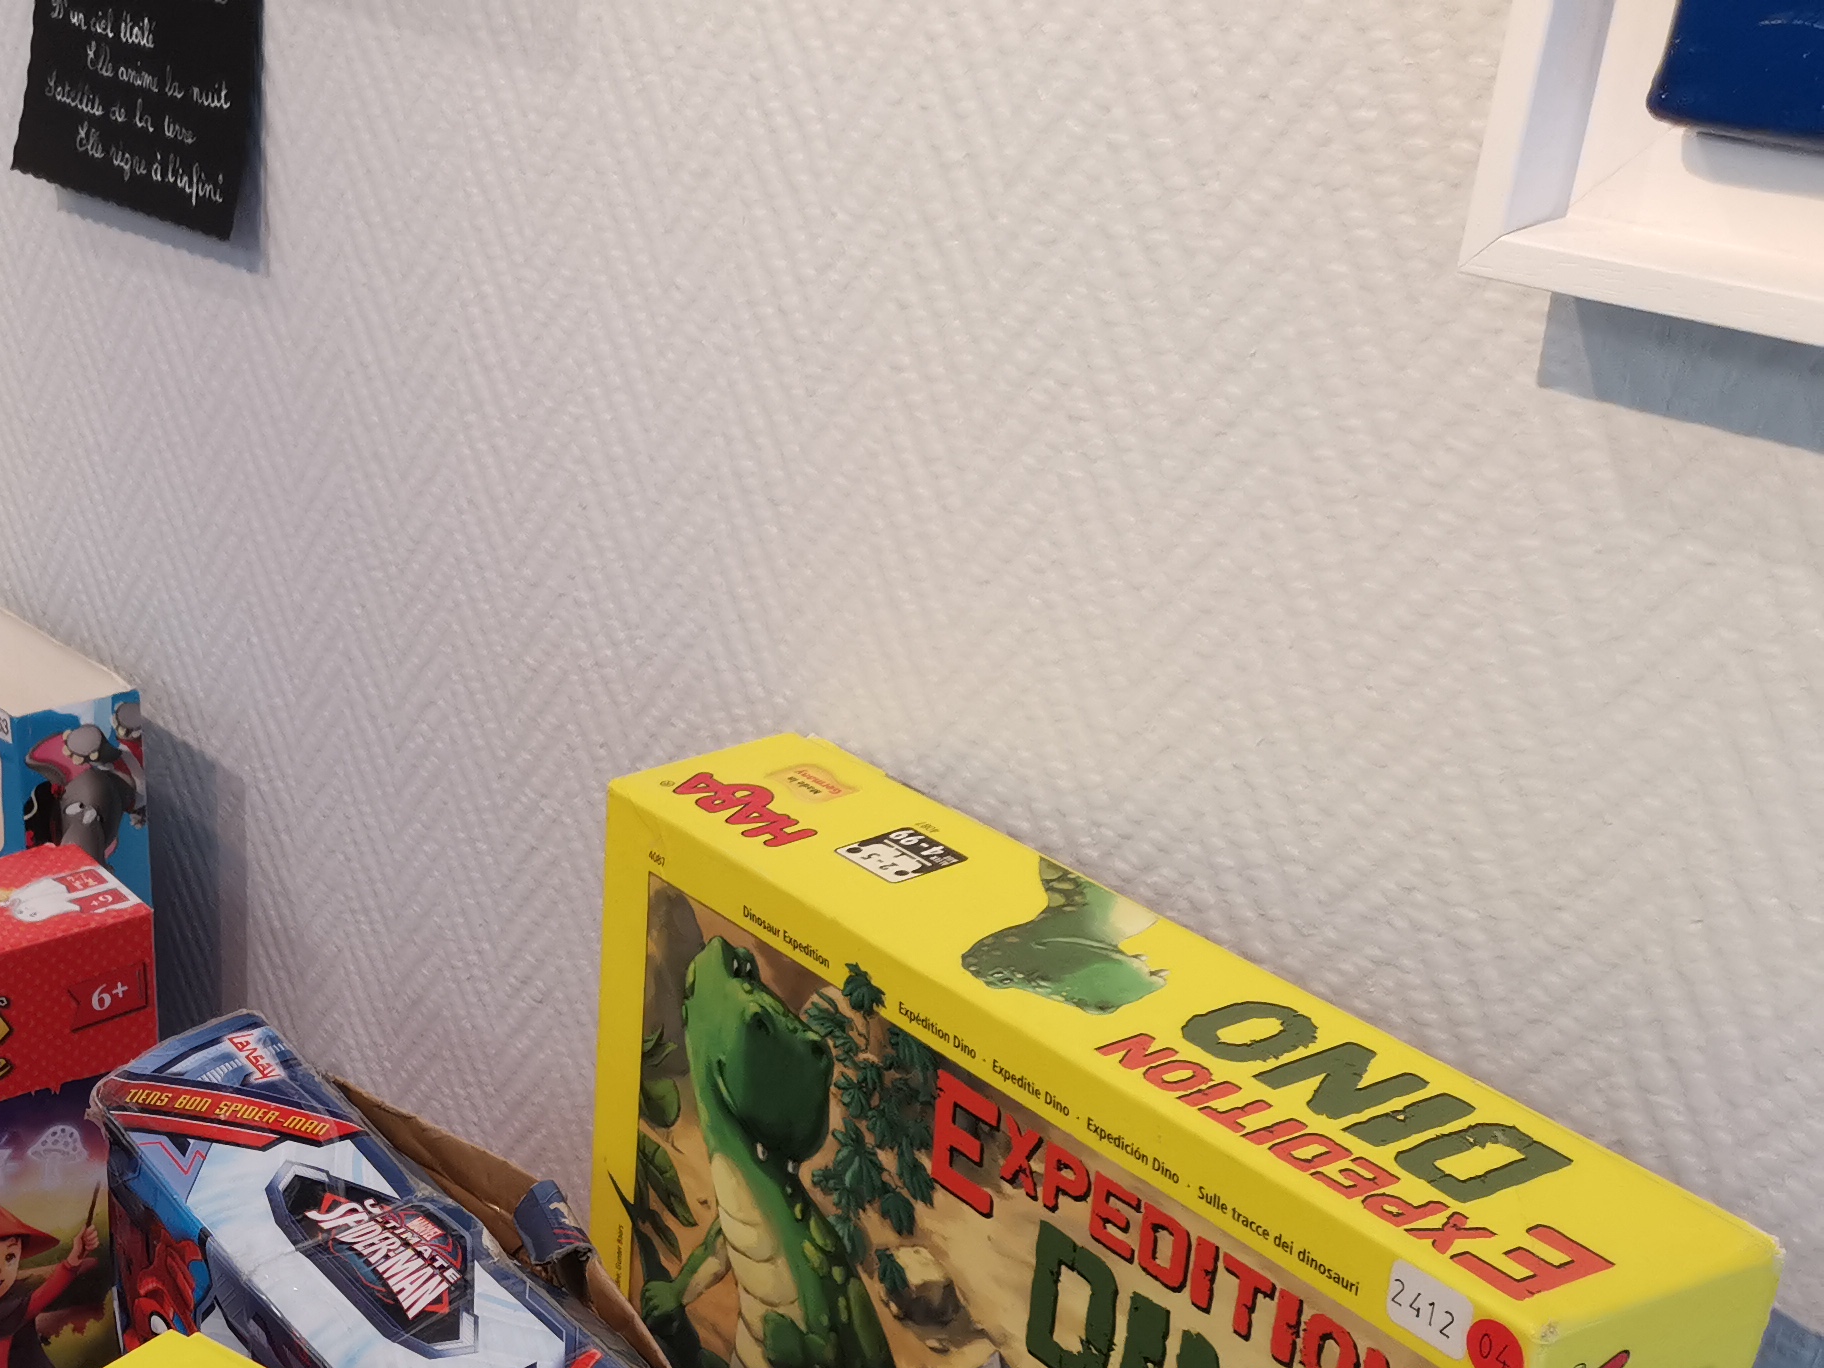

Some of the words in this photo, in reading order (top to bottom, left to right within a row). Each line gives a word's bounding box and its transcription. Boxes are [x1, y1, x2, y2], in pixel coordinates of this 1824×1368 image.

[120, 11, 155, 48] étoilé
[87, 44, 114, 76] Elle
[118, 64, 159, 93] anime
[165, 66, 184, 98] la
[192, 81, 230, 109] nuit
[110, 105, 126, 121] de
[135, 100, 154, 132] la
[164, 116, 196, 145] terre
[77, 122, 104, 160] Elle
[110, 144, 147, 180] règne
[167, 156, 223, 206] l'infini
[672, 771, 818, 848] HABA
[91, 981, 128, 1012] 6+
[126, 1088, 174, 1108] TIENS
[174, 1094, 214, 1114] BON
[214, 1101, 331, 1137] SPIDER-MAN
[742, 904, 782, 938] Dinosaur
[782, 929, 832, 969] Expedition
[897, 1000, 951, 1045] Expédition
[952, 1033, 978, 1061] Dino
[991, 1057, 1043, 1103] Expeditie
[1043, 1087, 1071, 1118] Dino
[1085, 1115, 1150, 1164] Expedición
[1151, 1153, 1181, 1186] Dino
[1196, 1185, 1230, 1217] Sulle
[1231, 1206, 1271, 1242] tracce
[1272, 1232, 1295, 1257] dei
[1296, 1244, 1361, 1297] dinosauri
[1181, 1000, 1575, 1204] DINO
[1093, 1032, 1616, 1302] EXPEDITION
[304, 1202, 451, 1320] SPIDER-MAN
[1391, 1276, 1457, 1341] 2412
